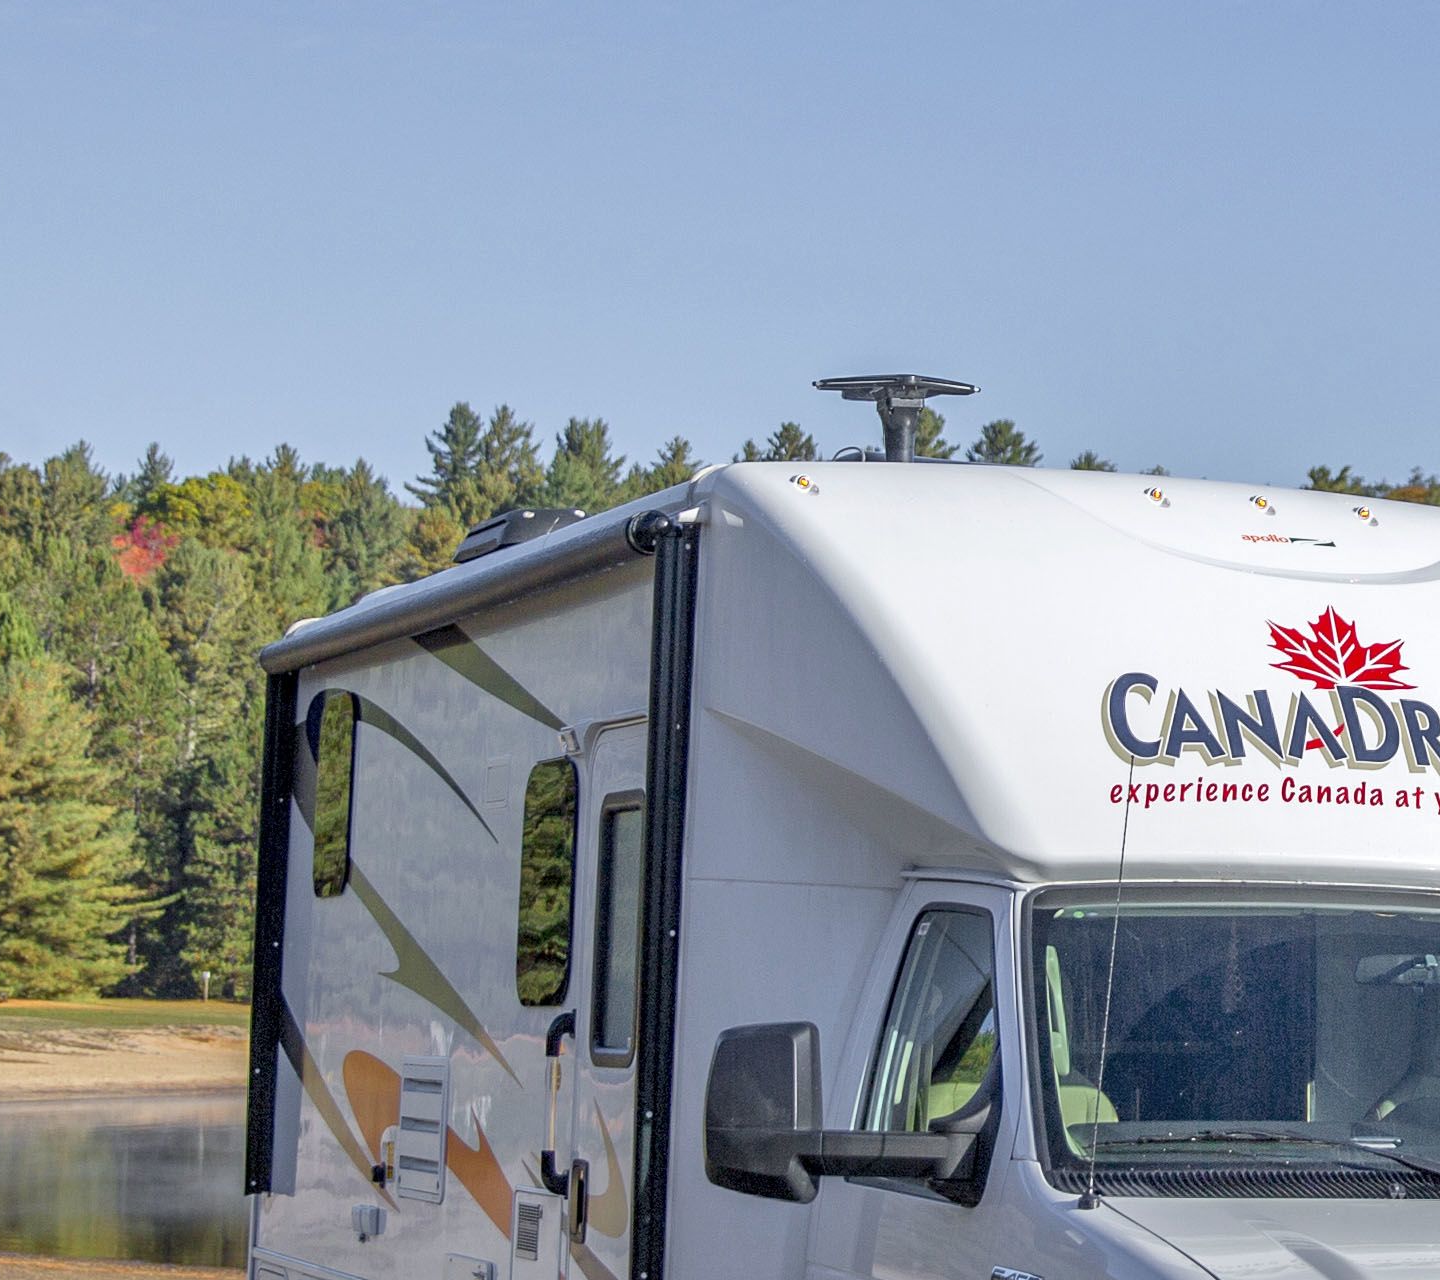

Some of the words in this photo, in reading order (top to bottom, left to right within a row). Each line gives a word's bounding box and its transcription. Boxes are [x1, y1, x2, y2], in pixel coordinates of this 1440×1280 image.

[1241, 533, 1289, 543] apollo
[1110, 776, 1270, 808] experience
[1281, 776, 1384, 807] Canada
[1395, 786, 1425, 809] at
